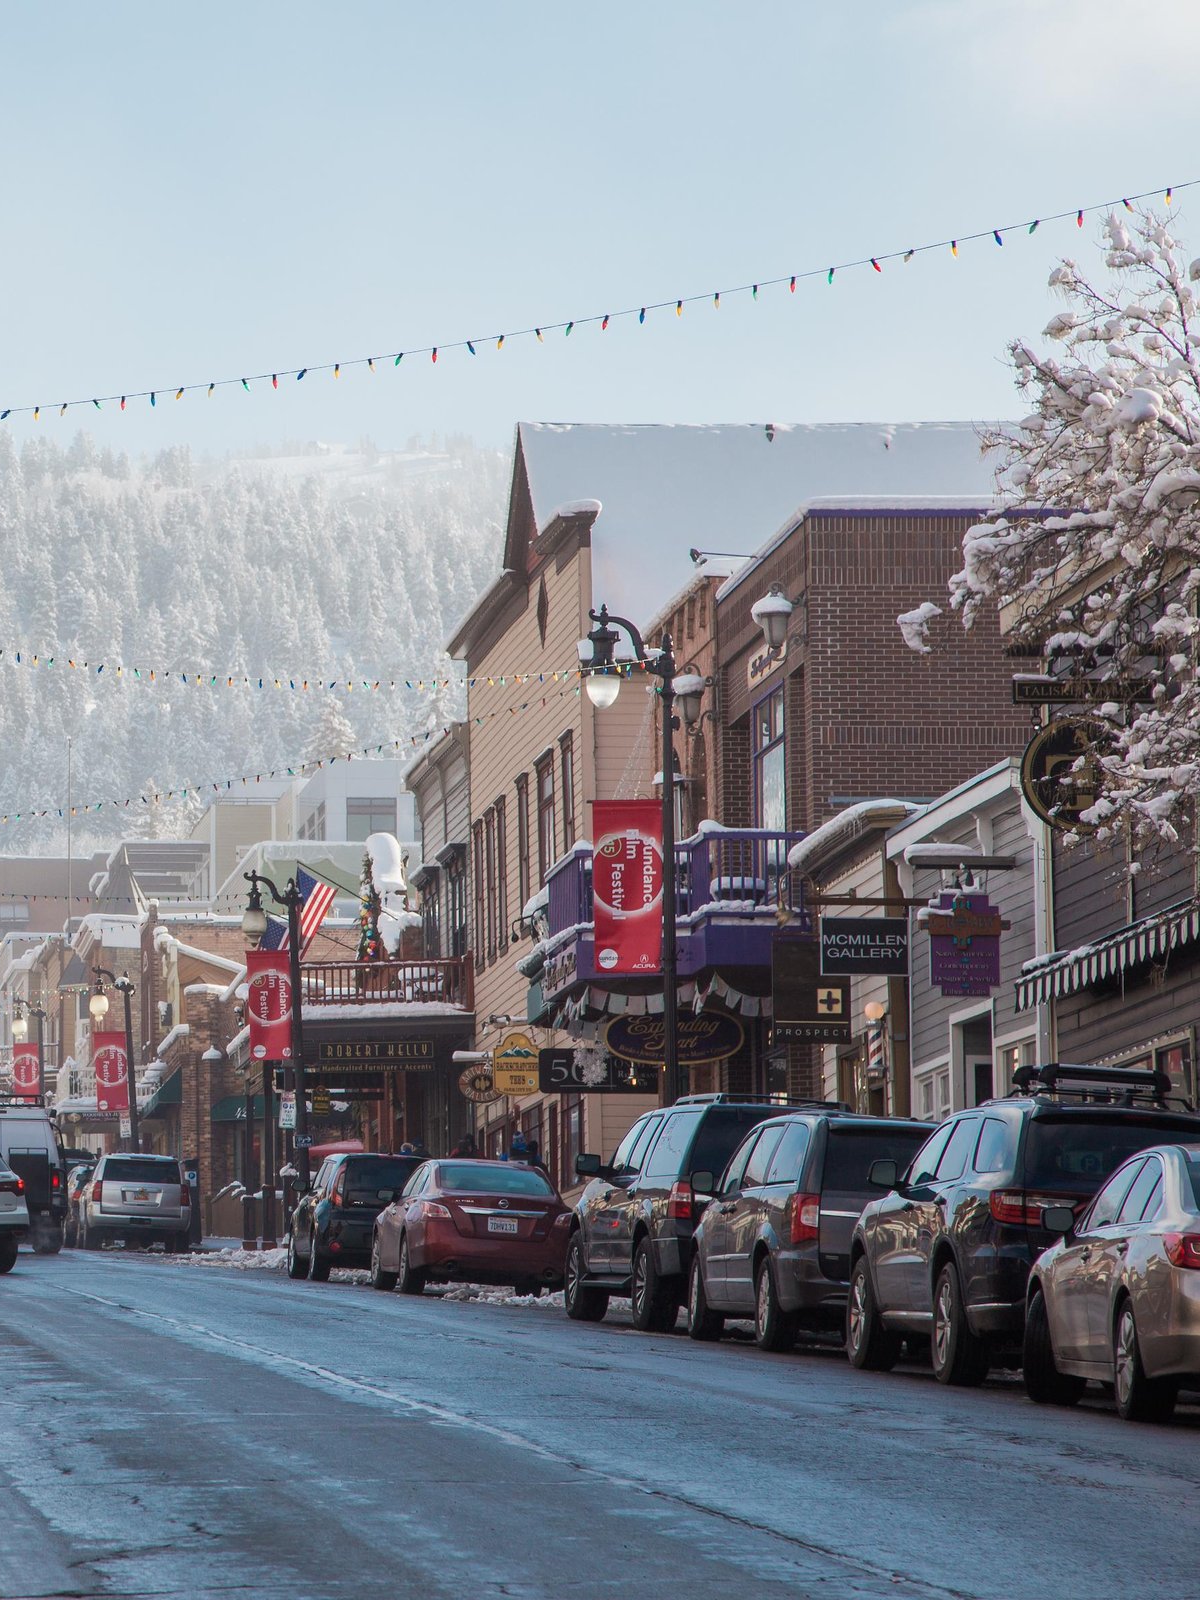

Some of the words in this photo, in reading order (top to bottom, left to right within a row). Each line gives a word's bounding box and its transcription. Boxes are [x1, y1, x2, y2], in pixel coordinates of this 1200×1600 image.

[823, 934, 907, 946] MCMILLEN
[827, 947, 903, 959] GALLERY
[628, 1015, 720, 1040] Expnding
[776, 1028, 849, 1037] PROSPECT
[326, 1045, 379, 1057] ROBERT
[387, 1043, 428, 1056] KELLY
